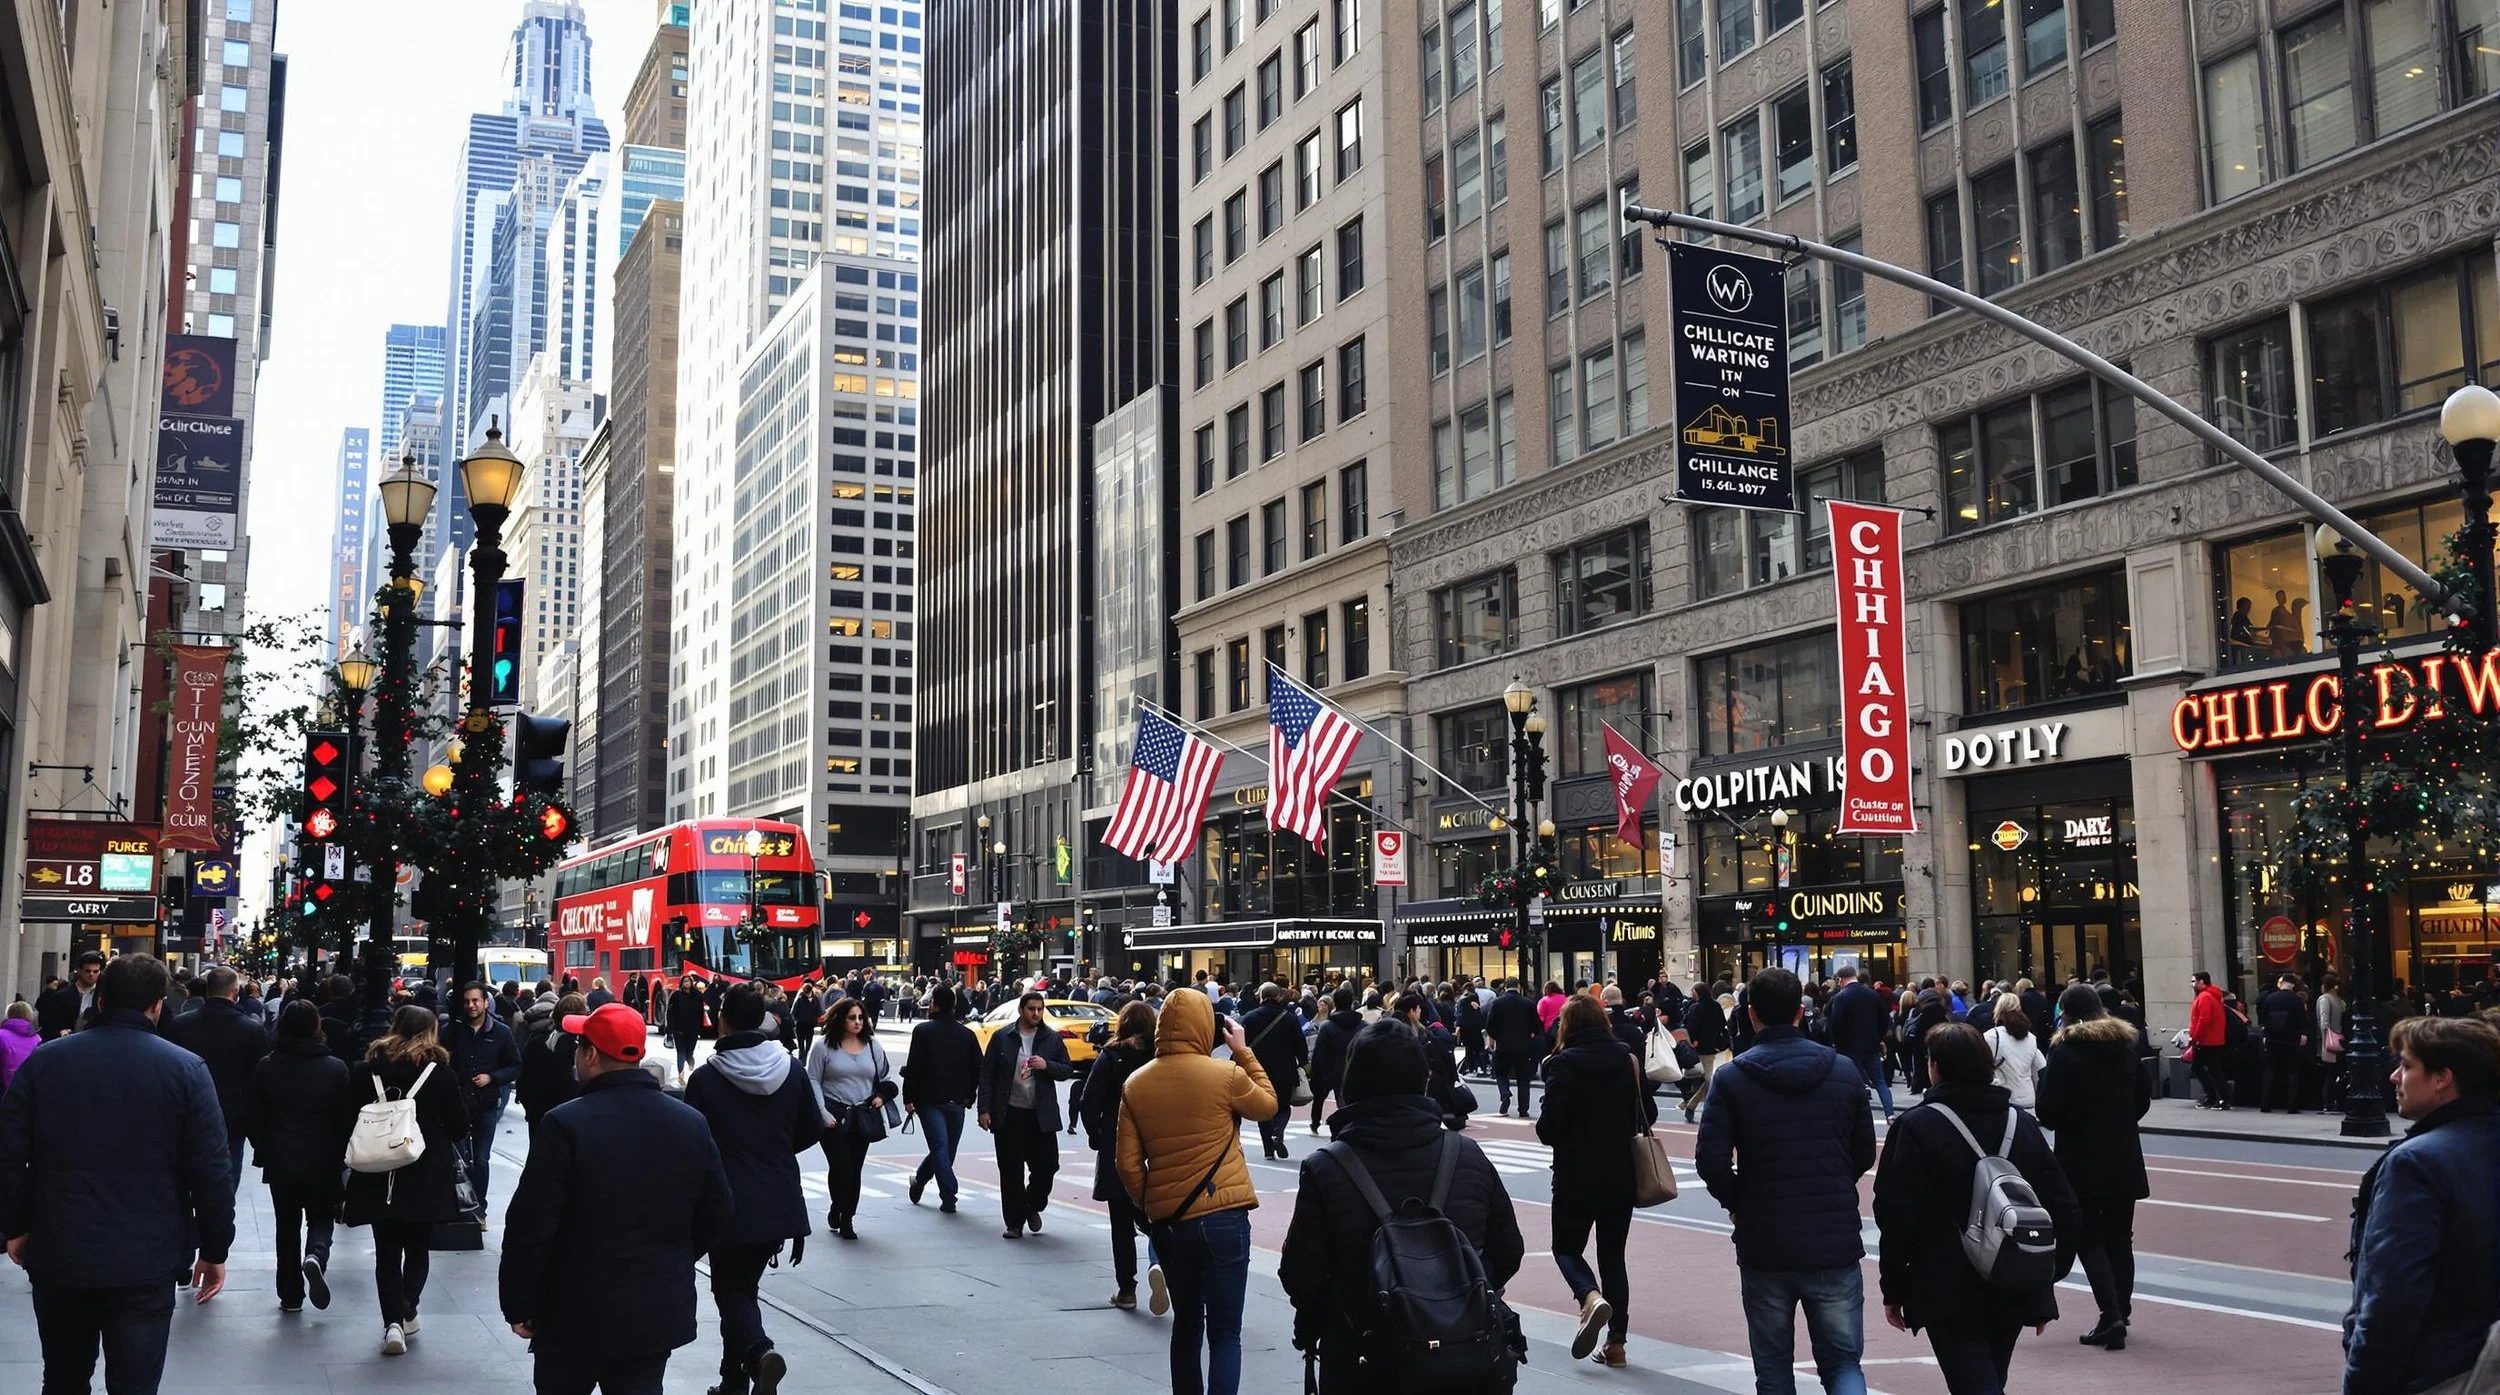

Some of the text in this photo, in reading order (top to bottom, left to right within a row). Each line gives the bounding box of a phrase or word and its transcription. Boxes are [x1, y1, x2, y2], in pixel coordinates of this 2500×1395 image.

[1683, 324, 1775, 351] CHLLICATE
[1690, 344, 1770, 369] WARTING
[1720, 368, 1743, 383] ITN
[1722, 387, 1740, 398] ON
[1688, 457, 1779, 481] CHILLANGE
[1849, 520, 1896, 784] CHHIAGO
[1945, 722, 2066, 770] DOTLY
[1675, 760, 1813, 812] COLPITAN
[65, 864, 93, 886] L8
